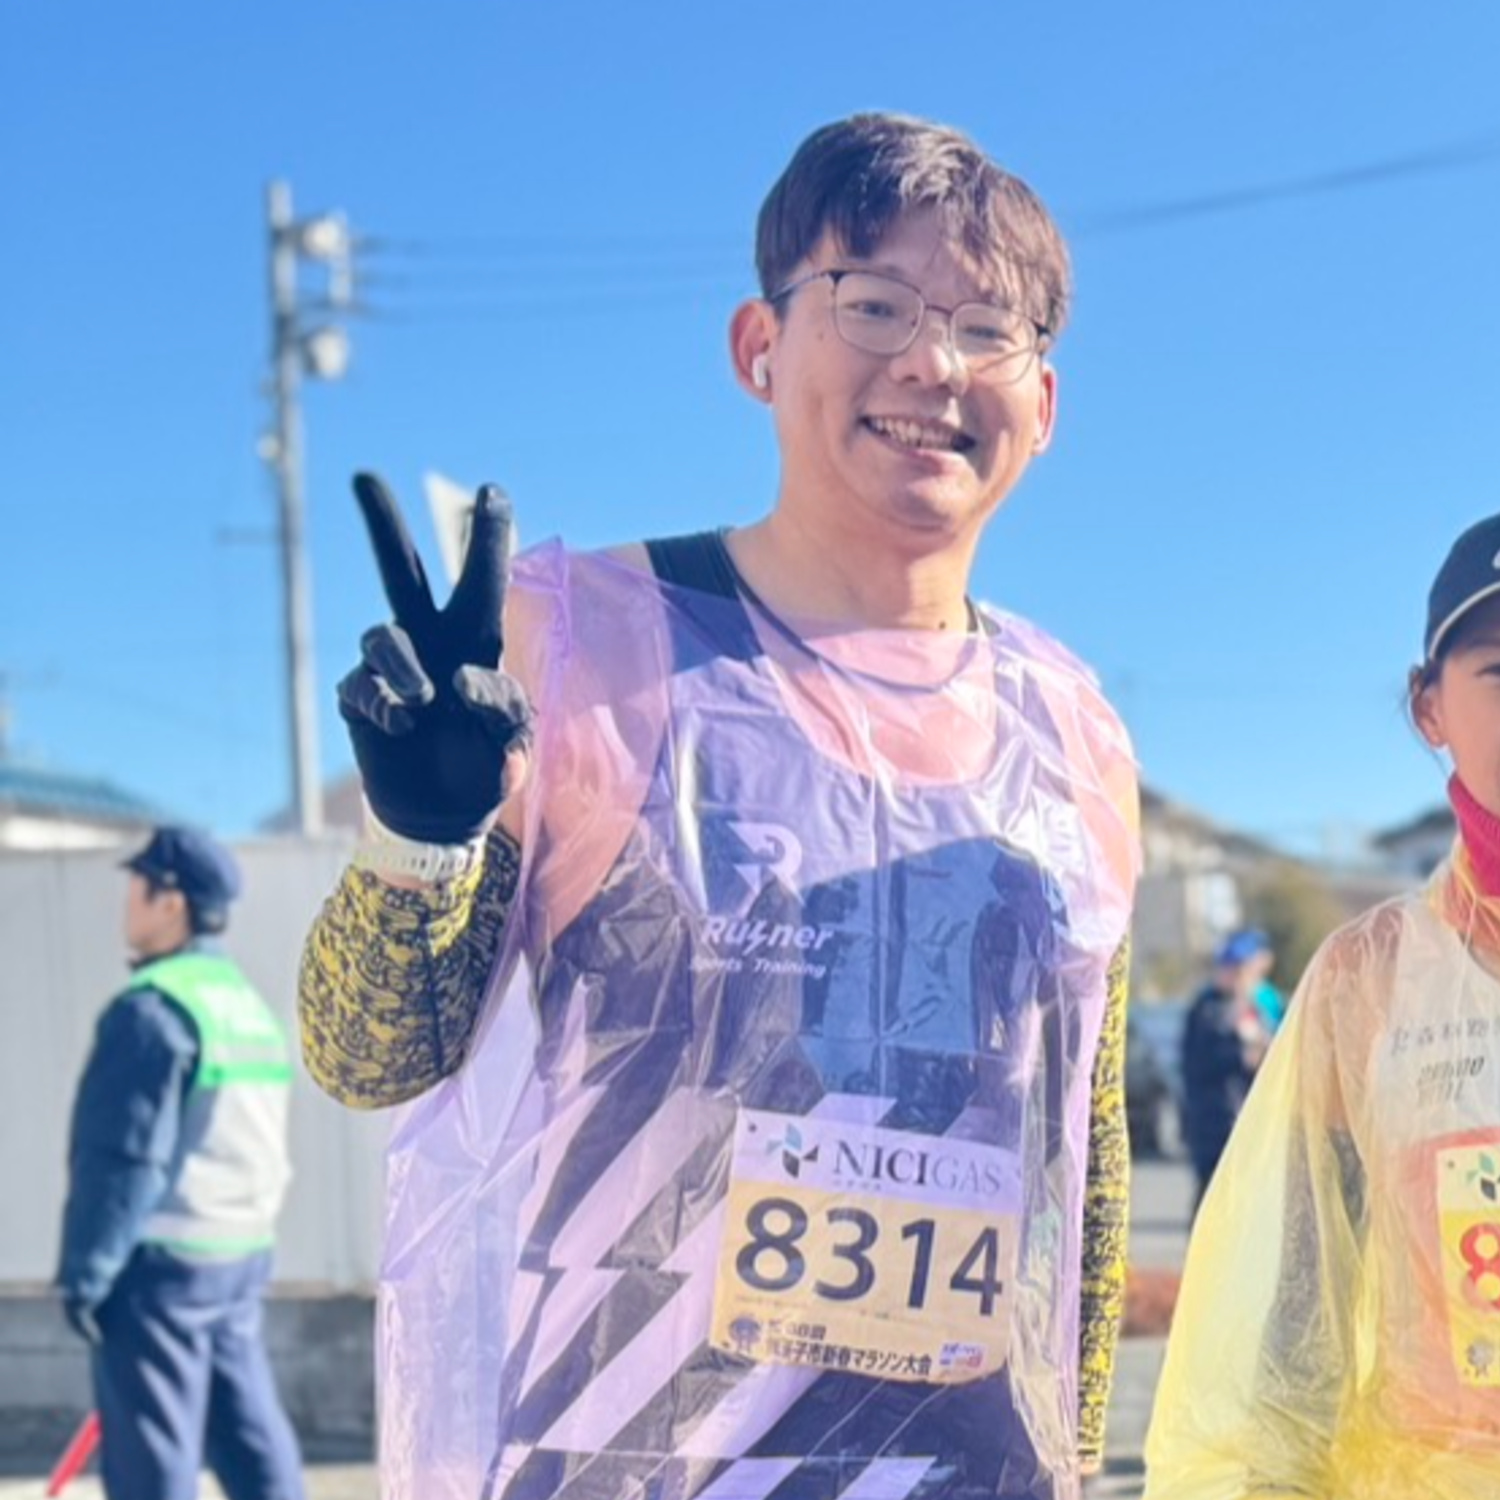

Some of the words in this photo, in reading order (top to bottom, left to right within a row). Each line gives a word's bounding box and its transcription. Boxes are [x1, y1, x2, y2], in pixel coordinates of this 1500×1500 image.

[754, 958, 827, 979] Training
[833, 1139, 1001, 1195] NICIGAS
[736, 1197, 1002, 1317] 8314
